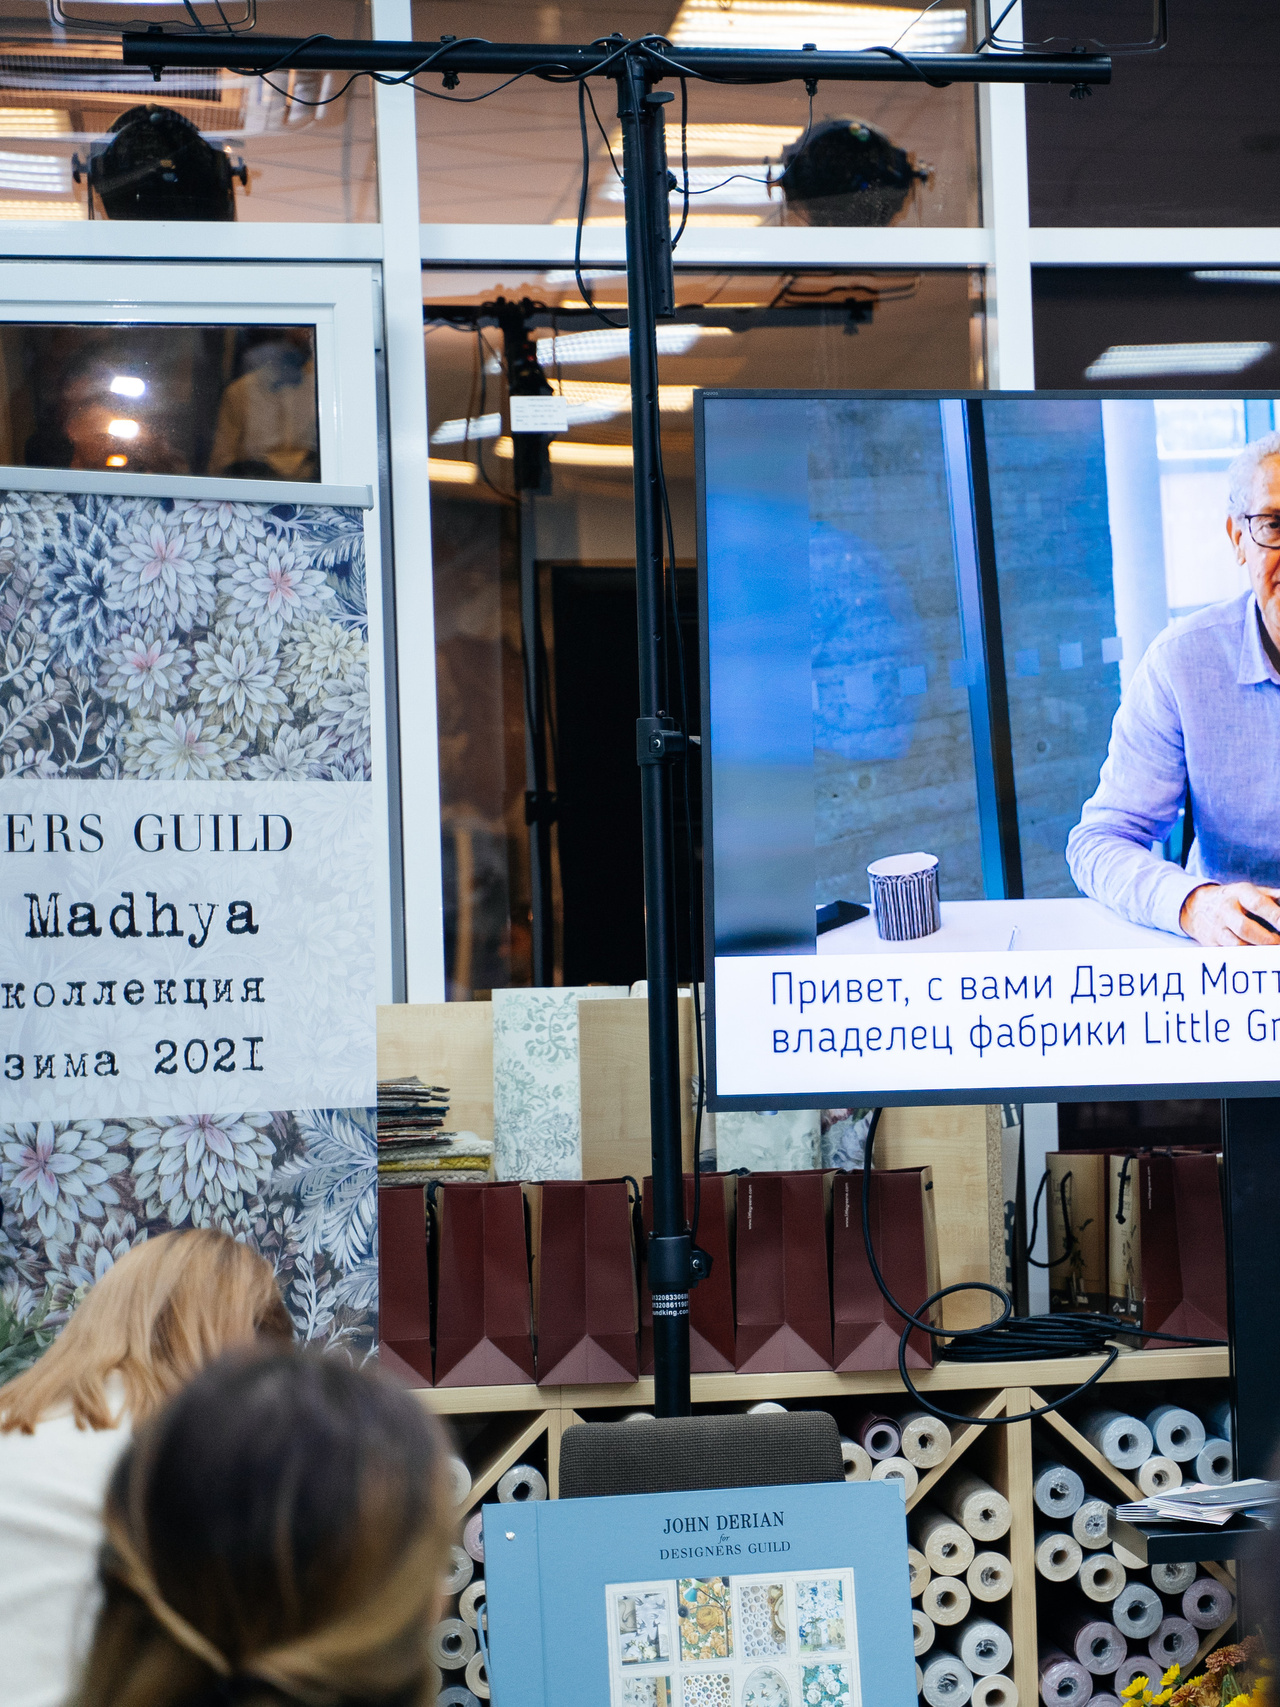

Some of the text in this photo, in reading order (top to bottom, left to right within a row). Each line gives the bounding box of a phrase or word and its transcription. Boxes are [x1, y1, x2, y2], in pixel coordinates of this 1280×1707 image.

[3, 813, 293, 853] ERS GUILD
[24, 891, 260, 948] Madhya
[1, 977, 266, 1010] коллекция
[772, 971, 910, 1014] Привет,
[928, 977, 943, 1001] с
[961, 975, 1052, 1000] вами
[1070, 965, 1185, 1004] Дэвид
[772, 1025, 953, 1058] владелец
[969, 1013, 1126, 1058] фабрики
[1144, 1009, 1231, 1045] Little
[4, 1036, 264, 1081] зима 2021
[663, 1511, 785, 1535] JOHN DERIAN
[718, 1533, 730, 1544] for
[659, 1540, 791, 1560] DESIGNERS GUILD
